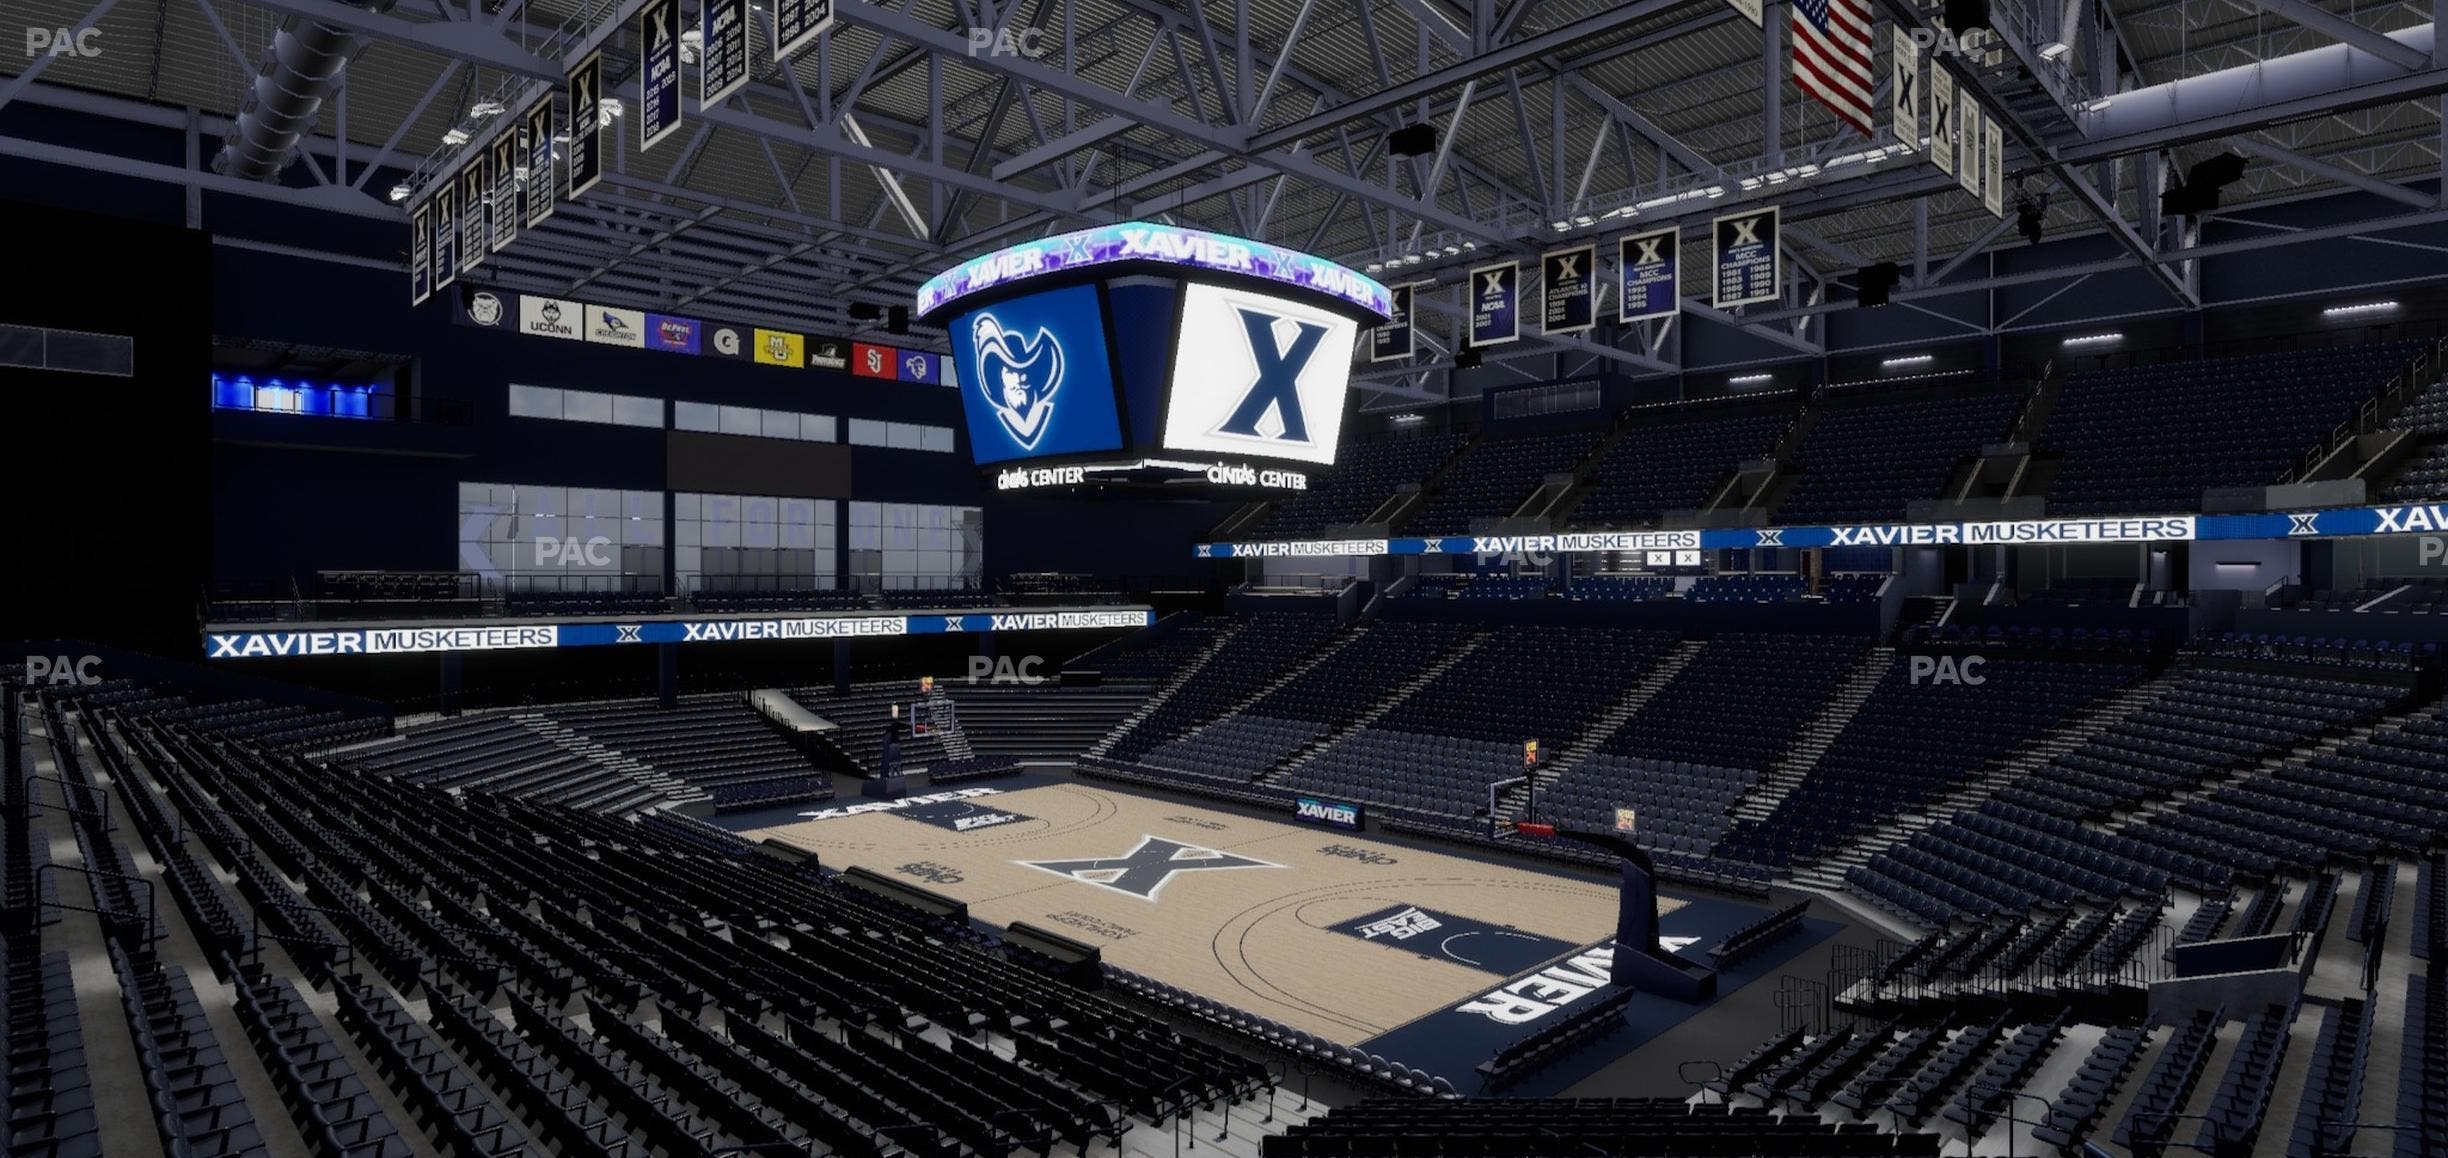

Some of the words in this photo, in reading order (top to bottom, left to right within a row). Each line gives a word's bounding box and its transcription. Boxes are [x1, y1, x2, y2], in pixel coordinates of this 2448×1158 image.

[781, 5, 799, 28] 1997
[804, 2, 825, 27] 2004
[1730, 217, 1762, 248] X
[1118, 228, 1253, 270] XAVIER
[1634, 236, 1664, 267] X
[1735, 250, 1758, 261] MCC
[967, 247, 1044, 289] XAVIER
[1640, 269, 1660, 279] MCC
[1721, 255, 1771, 270] CHAMPIONS
[1310, 260, 1376, 305] XAVIER
[1627, 273, 1672, 287] CHAMPIONS
[1548, 288, 1588, 301] CHAMPIONS
[530, 321, 572, 335] UCONN
[1212, 303, 1333, 445] X
[1031, 466, 1085, 487] CENTER
[1259, 470, 1307, 490] CENTER
[711, 498, 811, 548] FOR
[1830, 525, 1959, 546] XAVIER
[1971, 519, 2189, 542] MUSKETEERS
[1232, 543, 1290, 557] XAVIER
[1293, 541, 1385, 555] MUSKETEERS
[1473, 536, 1556, 552] XAVIER
[1562, 533, 1696, 549] MUSKETEERS
[683, 621, 781, 641] XAVIER
[786, 618, 904, 636] MUSKETEERS
[991, 614, 1058, 631] XAVIER
[1062, 612, 1145, 628] MUSKETEERS
[210, 633, 364, 658] XAVIER
[375, 628, 553, 650] MUSKETEERS
[1297, 802, 1356, 825] XAVIER
[1012, 833, 1291, 903] X
[1358, 910, 1430, 939] EAST
[1390, 917, 1443, 940] BIG
